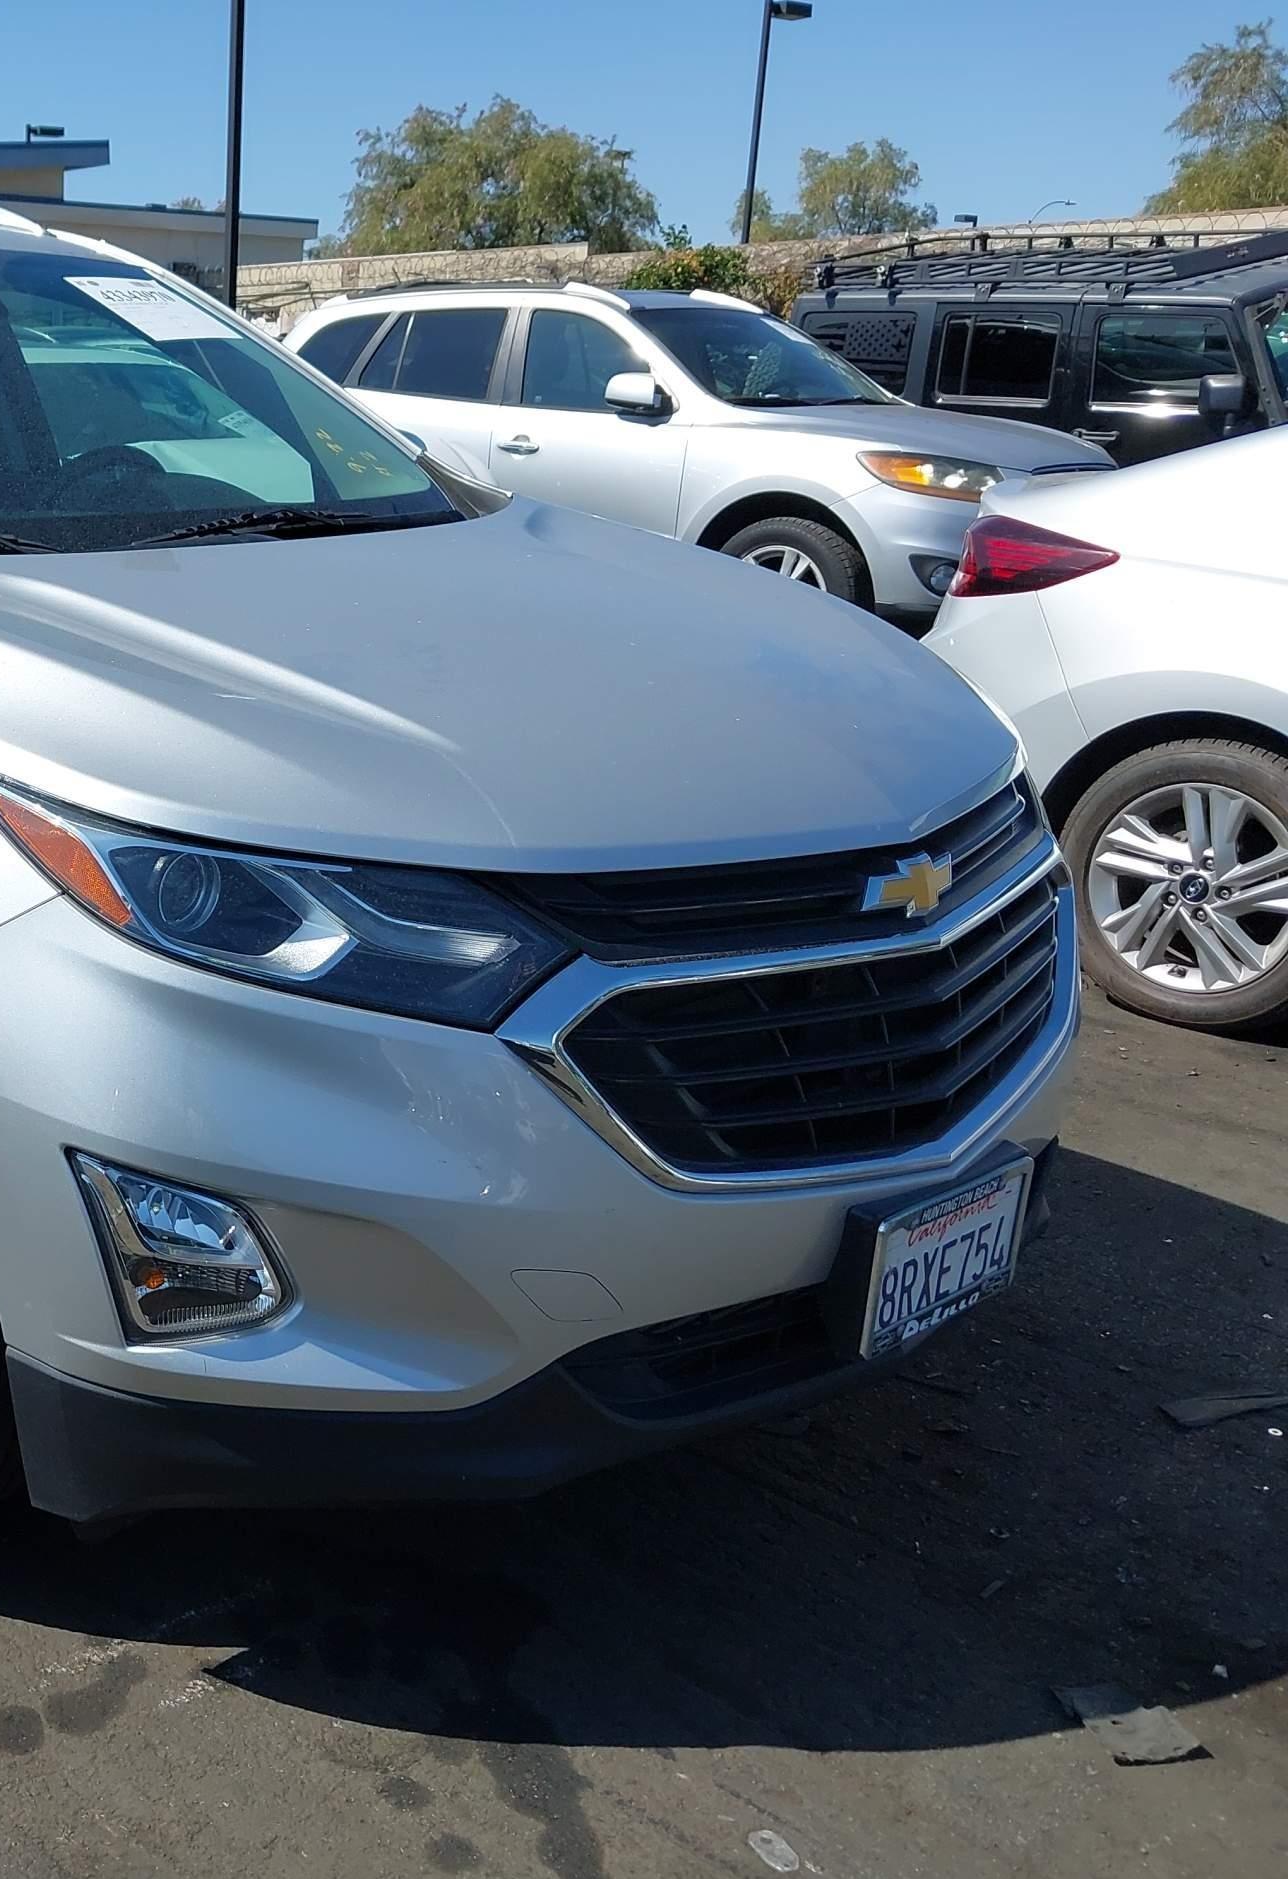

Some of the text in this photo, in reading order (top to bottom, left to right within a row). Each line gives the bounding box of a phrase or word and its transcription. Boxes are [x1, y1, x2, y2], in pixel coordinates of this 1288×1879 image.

[920, 1180, 1000, 1223] HUNTINGTON BEACH
[879, 1216, 1005, 1328] 8RXE754
